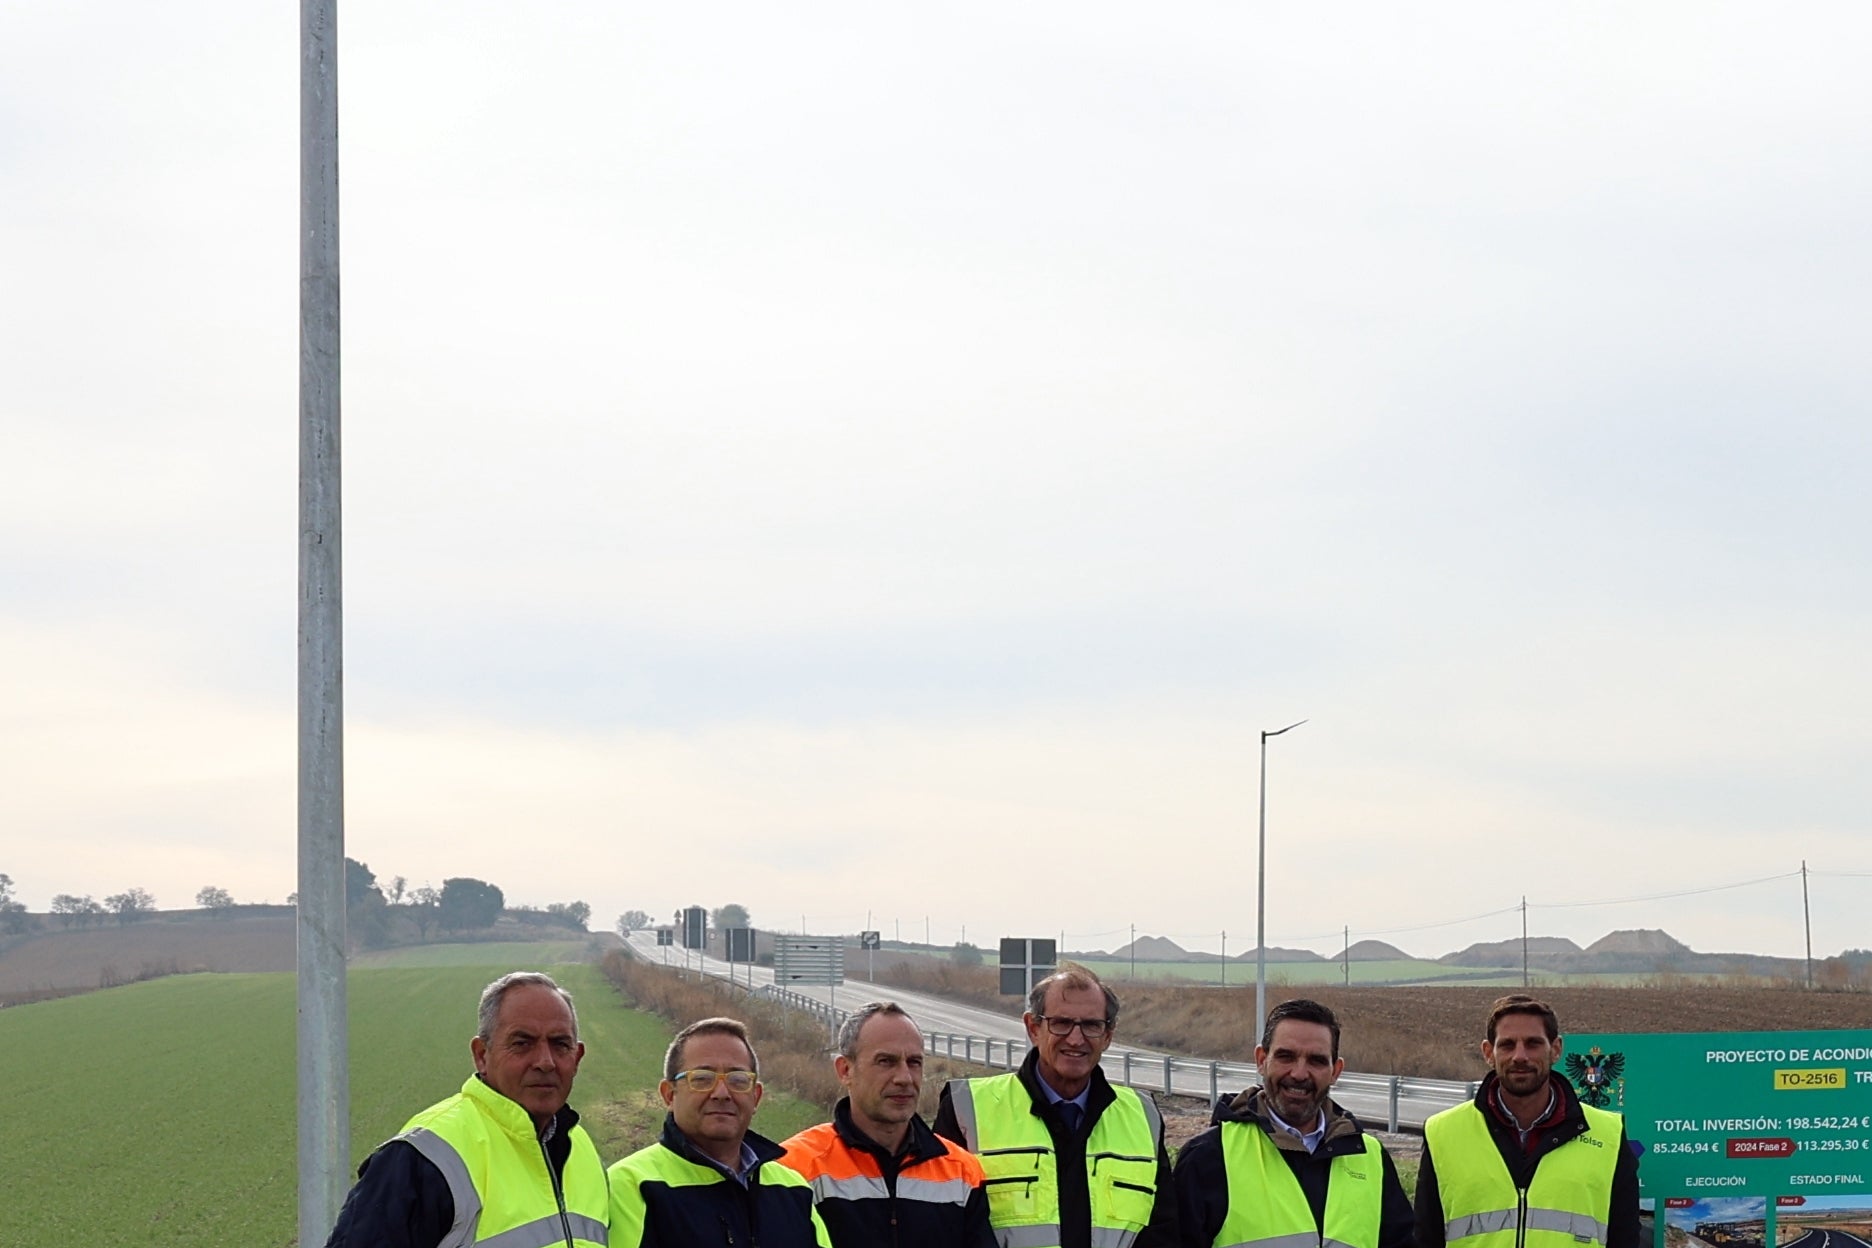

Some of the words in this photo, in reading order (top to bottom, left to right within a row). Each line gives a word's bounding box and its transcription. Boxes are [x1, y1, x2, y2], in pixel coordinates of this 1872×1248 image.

[1706, 1049, 1785, 1062] PROYECTO
[1789, 1048, 1809, 1060] DE
[1781, 1074, 1837, 1085] TO-2516
[1656, 1119, 1699, 1132] TOTAL
[1702, 1115, 1781, 1131] INVERSIÓN:
[1787, 1116, 1858, 1132] 198.542,24
[1861, 1116, 1869, 1128] €
[1580, 1134, 1603, 1148] Tolsa
[1734, 1143, 1757, 1152] 2024
[1758, 1142, 1779, 1151] Fase
[1780, 1142, 1787, 1151] 2
[1795, 1139, 1859, 1153] 113.295,30
[1861, 1139, 1869, 1150] €
[1653, 1142, 1709, 1155] 85.246,94
[1711, 1142, 1718, 1152] €
[1685, 1173, 1746, 1186] EJECUCIÓN
[1789, 1174, 1832, 1184] ESTADO
[1834, 1174, 1864, 1184] FINAL
